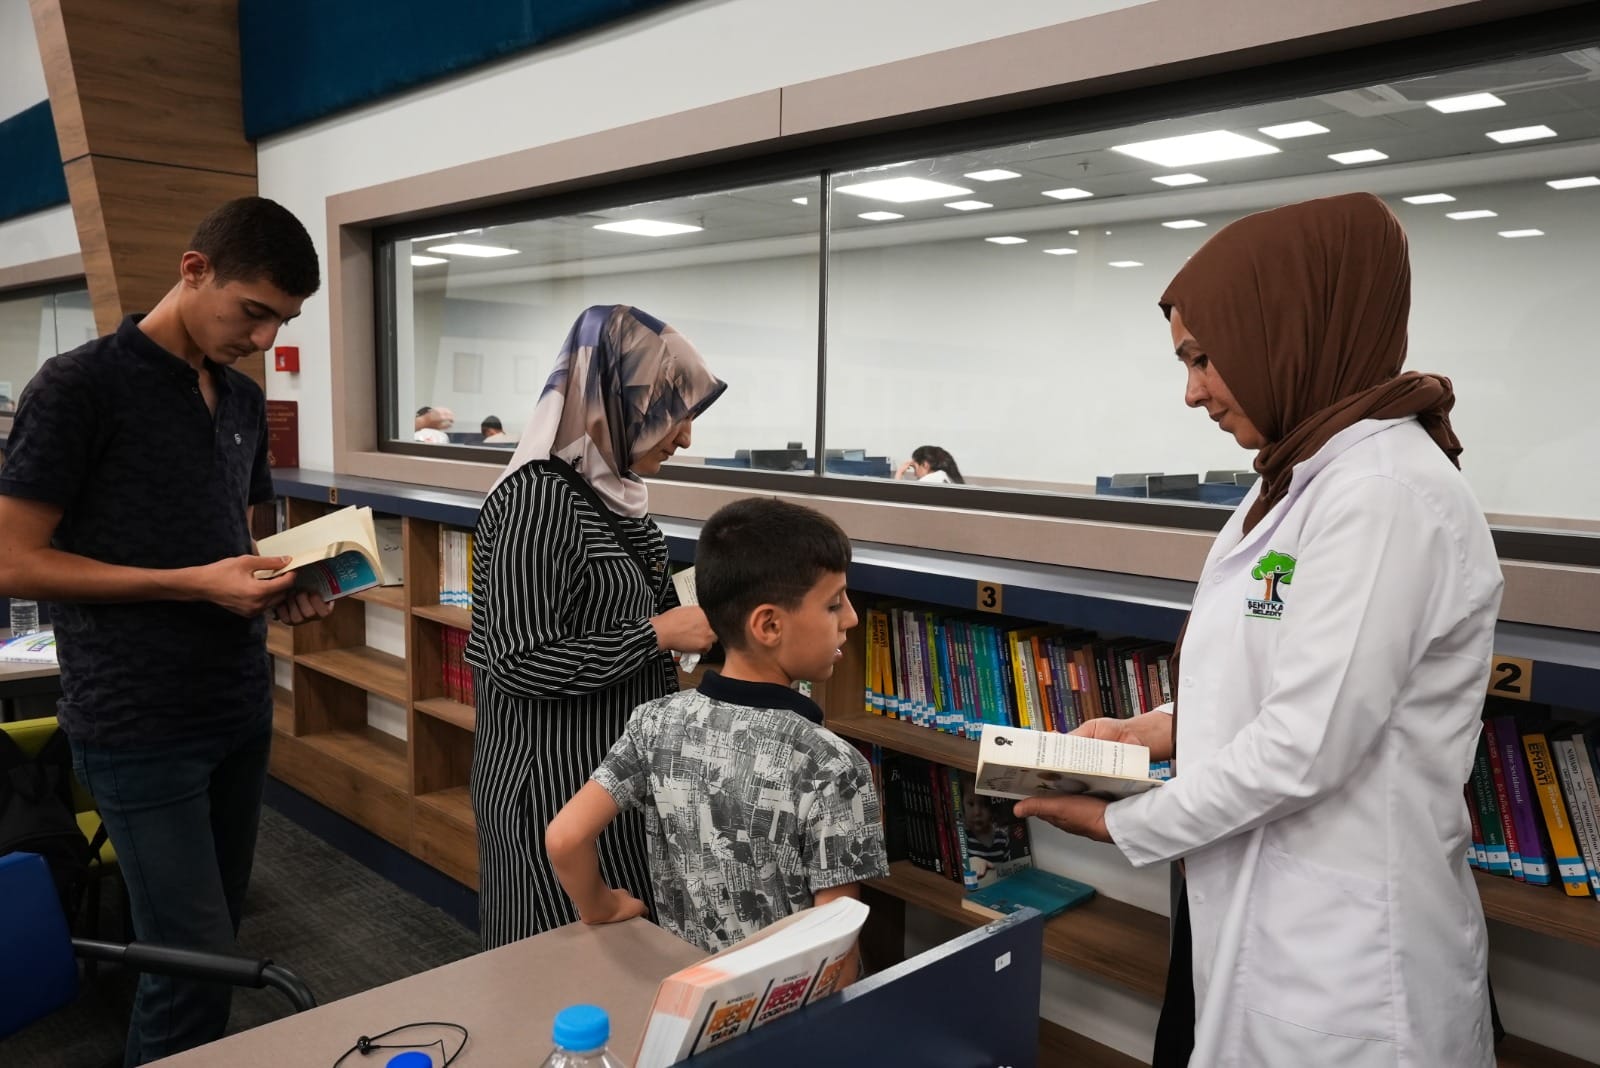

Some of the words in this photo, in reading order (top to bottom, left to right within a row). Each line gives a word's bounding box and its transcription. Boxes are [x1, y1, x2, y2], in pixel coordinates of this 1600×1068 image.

[982, 586, 997, 608] 3
[1493, 662, 1522, 693] 2
[1528, 743, 1549, 786] EMPATİ
